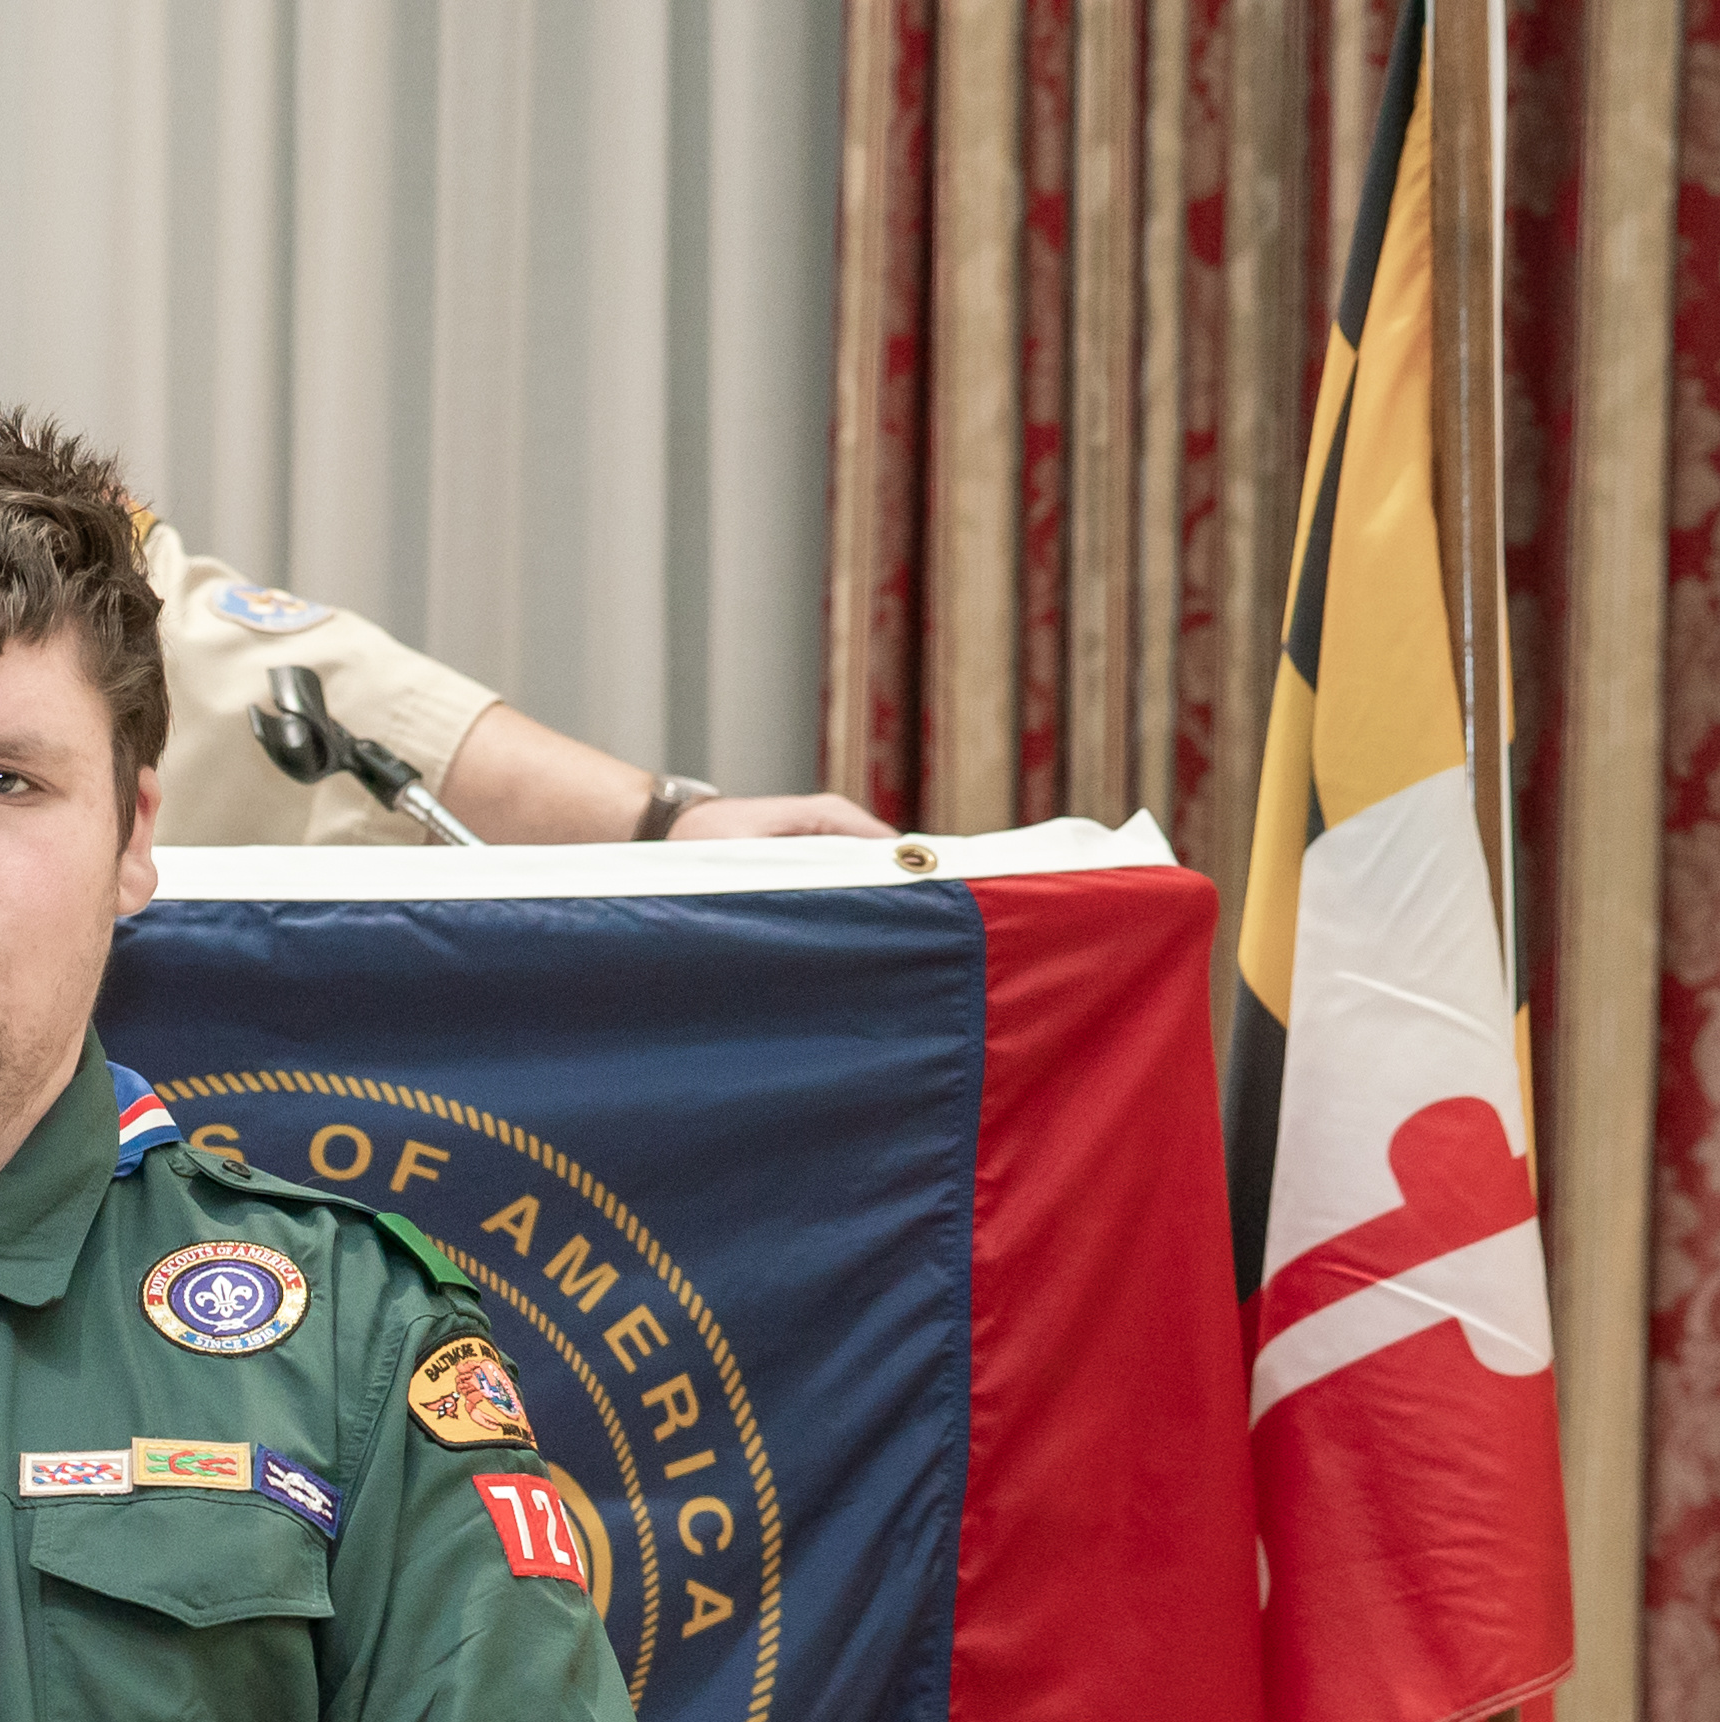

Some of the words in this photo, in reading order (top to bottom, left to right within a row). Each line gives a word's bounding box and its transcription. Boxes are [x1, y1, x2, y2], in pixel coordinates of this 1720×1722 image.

[148, 1270, 166, 1296] BOY
[163, 1246, 214, 1277] SCOUTS
[233, 1246, 298, 1282] AMERICA
[194, 1336, 243, 1349] SINCE
[245, 1327, 276, 1347] 1910
[309, 1124, 451, 1194] OF
[481, 1195, 734, 1640] AMERICA
[424, 1342, 478, 1383] BALTIMORE
